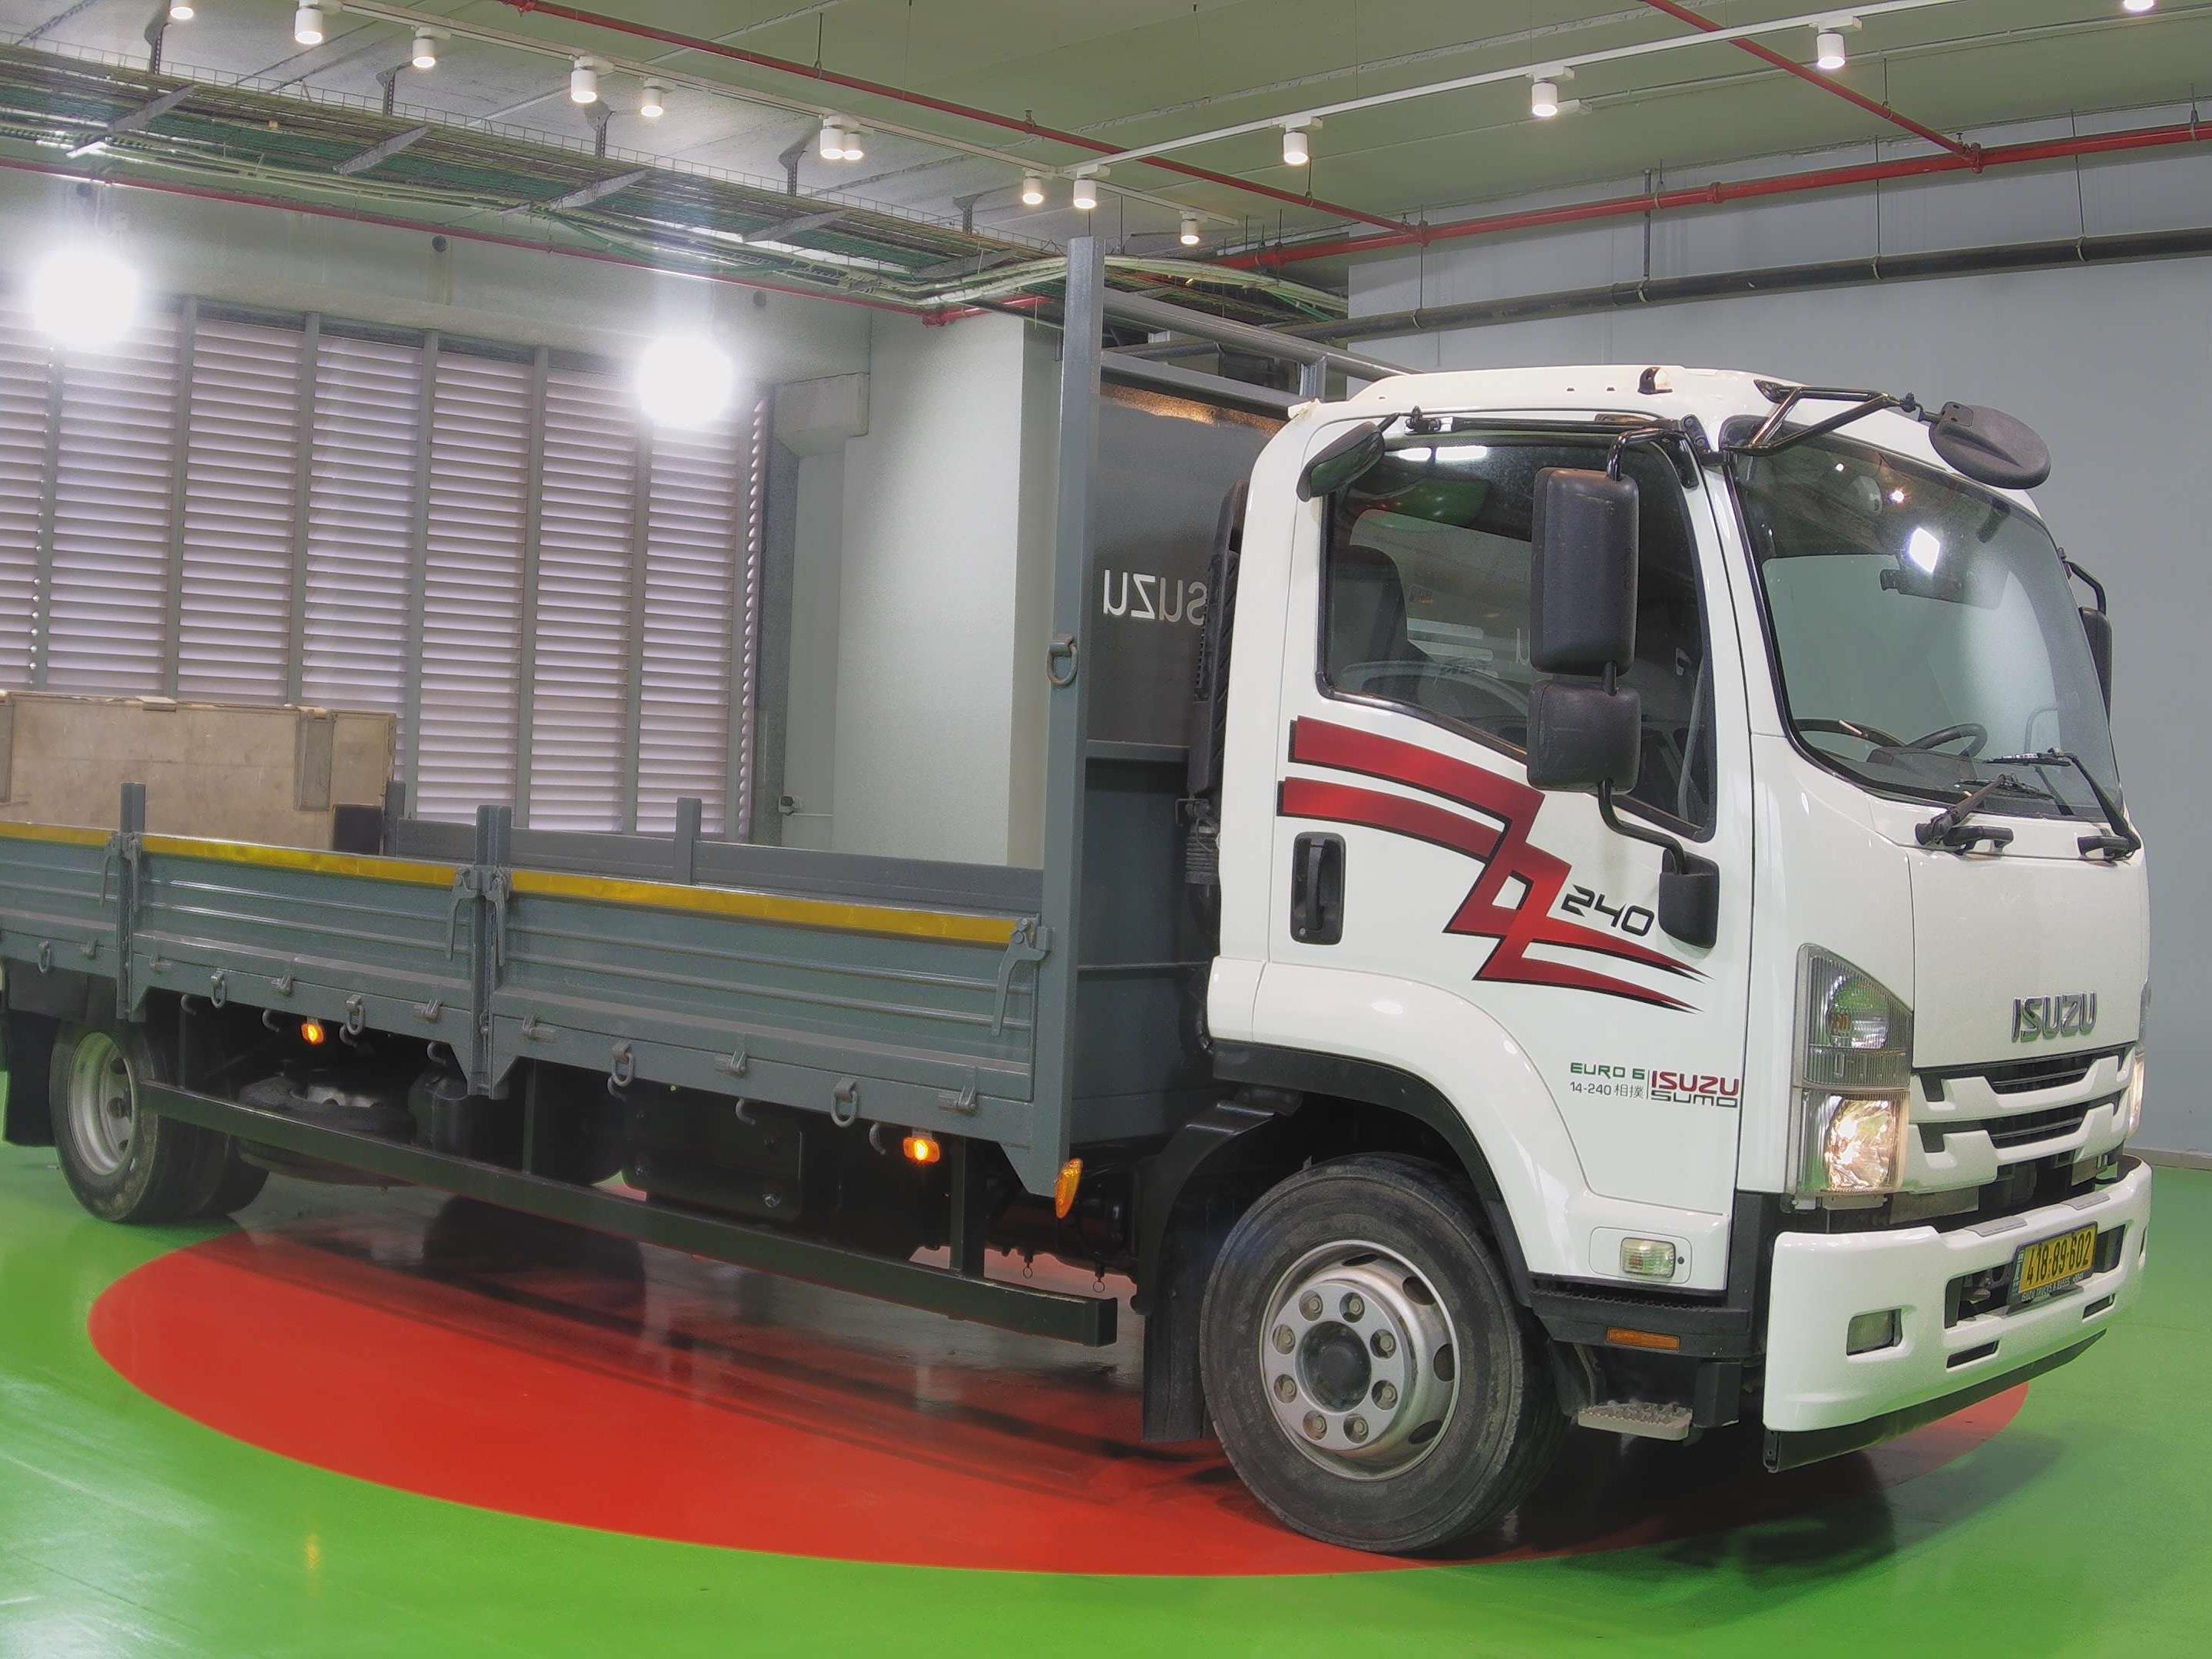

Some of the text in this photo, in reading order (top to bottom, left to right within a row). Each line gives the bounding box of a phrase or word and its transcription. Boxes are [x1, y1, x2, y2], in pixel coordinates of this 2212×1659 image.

[1561, 884, 1654, 937] 240
[2011, 989, 2098, 1043] ISUZU
[1570, 1062, 1645, 1080] EURO 6
[1569, 1081, 1611, 1096] 14-240
[1651, 1070, 1740, 1096] ISUZU
[1651, 1090, 1738, 1108] SUMO
